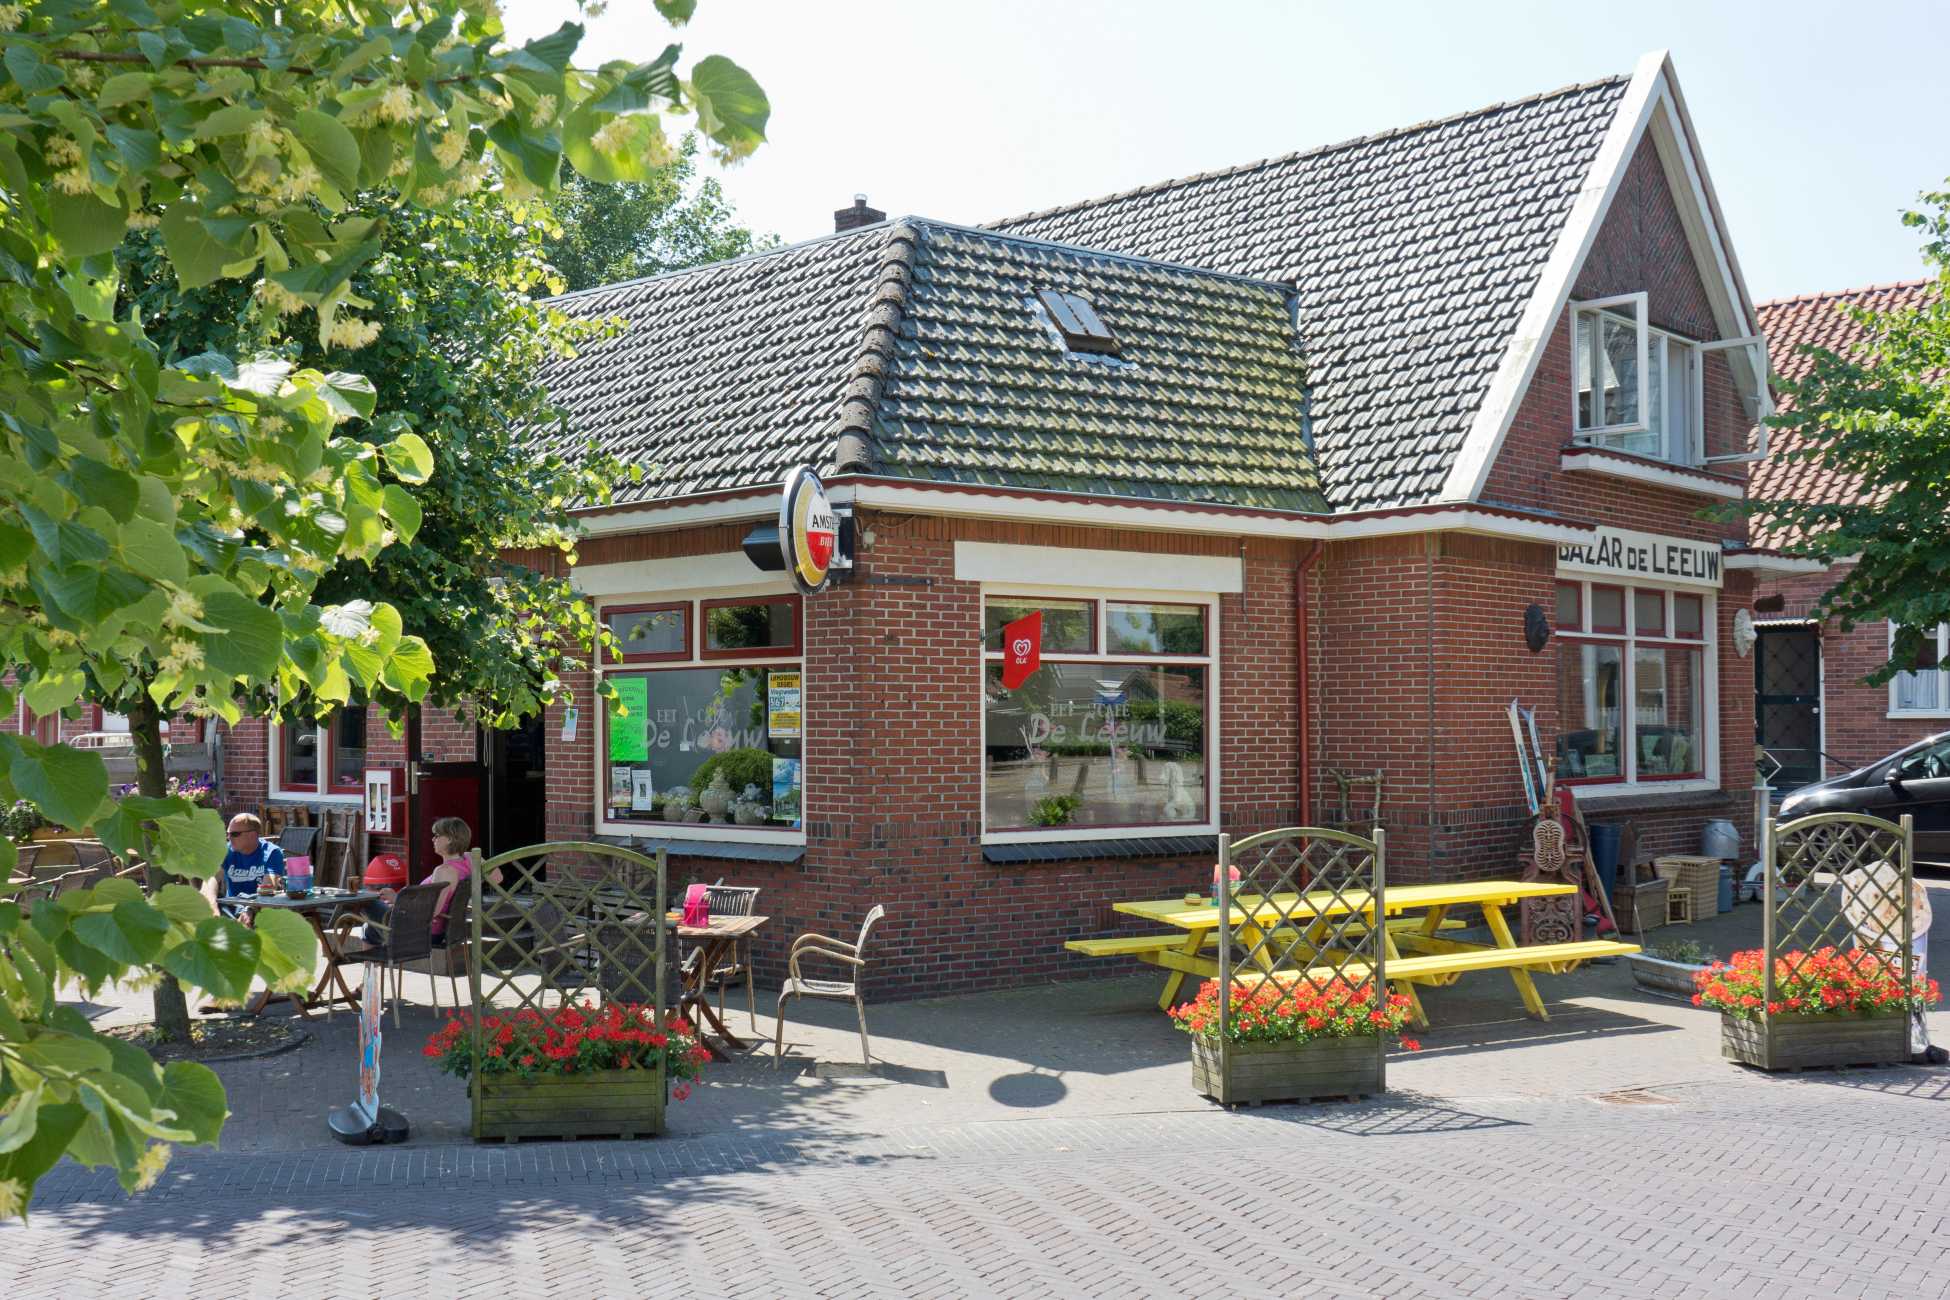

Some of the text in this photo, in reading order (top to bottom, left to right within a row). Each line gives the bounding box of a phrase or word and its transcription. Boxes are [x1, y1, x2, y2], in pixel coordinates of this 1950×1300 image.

[1627, 547, 1648, 572] DE
[1652, 543, 1719, 580] LEEUW
[656, 709, 677, 723] EET
[1029, 712, 1067, 744] De
